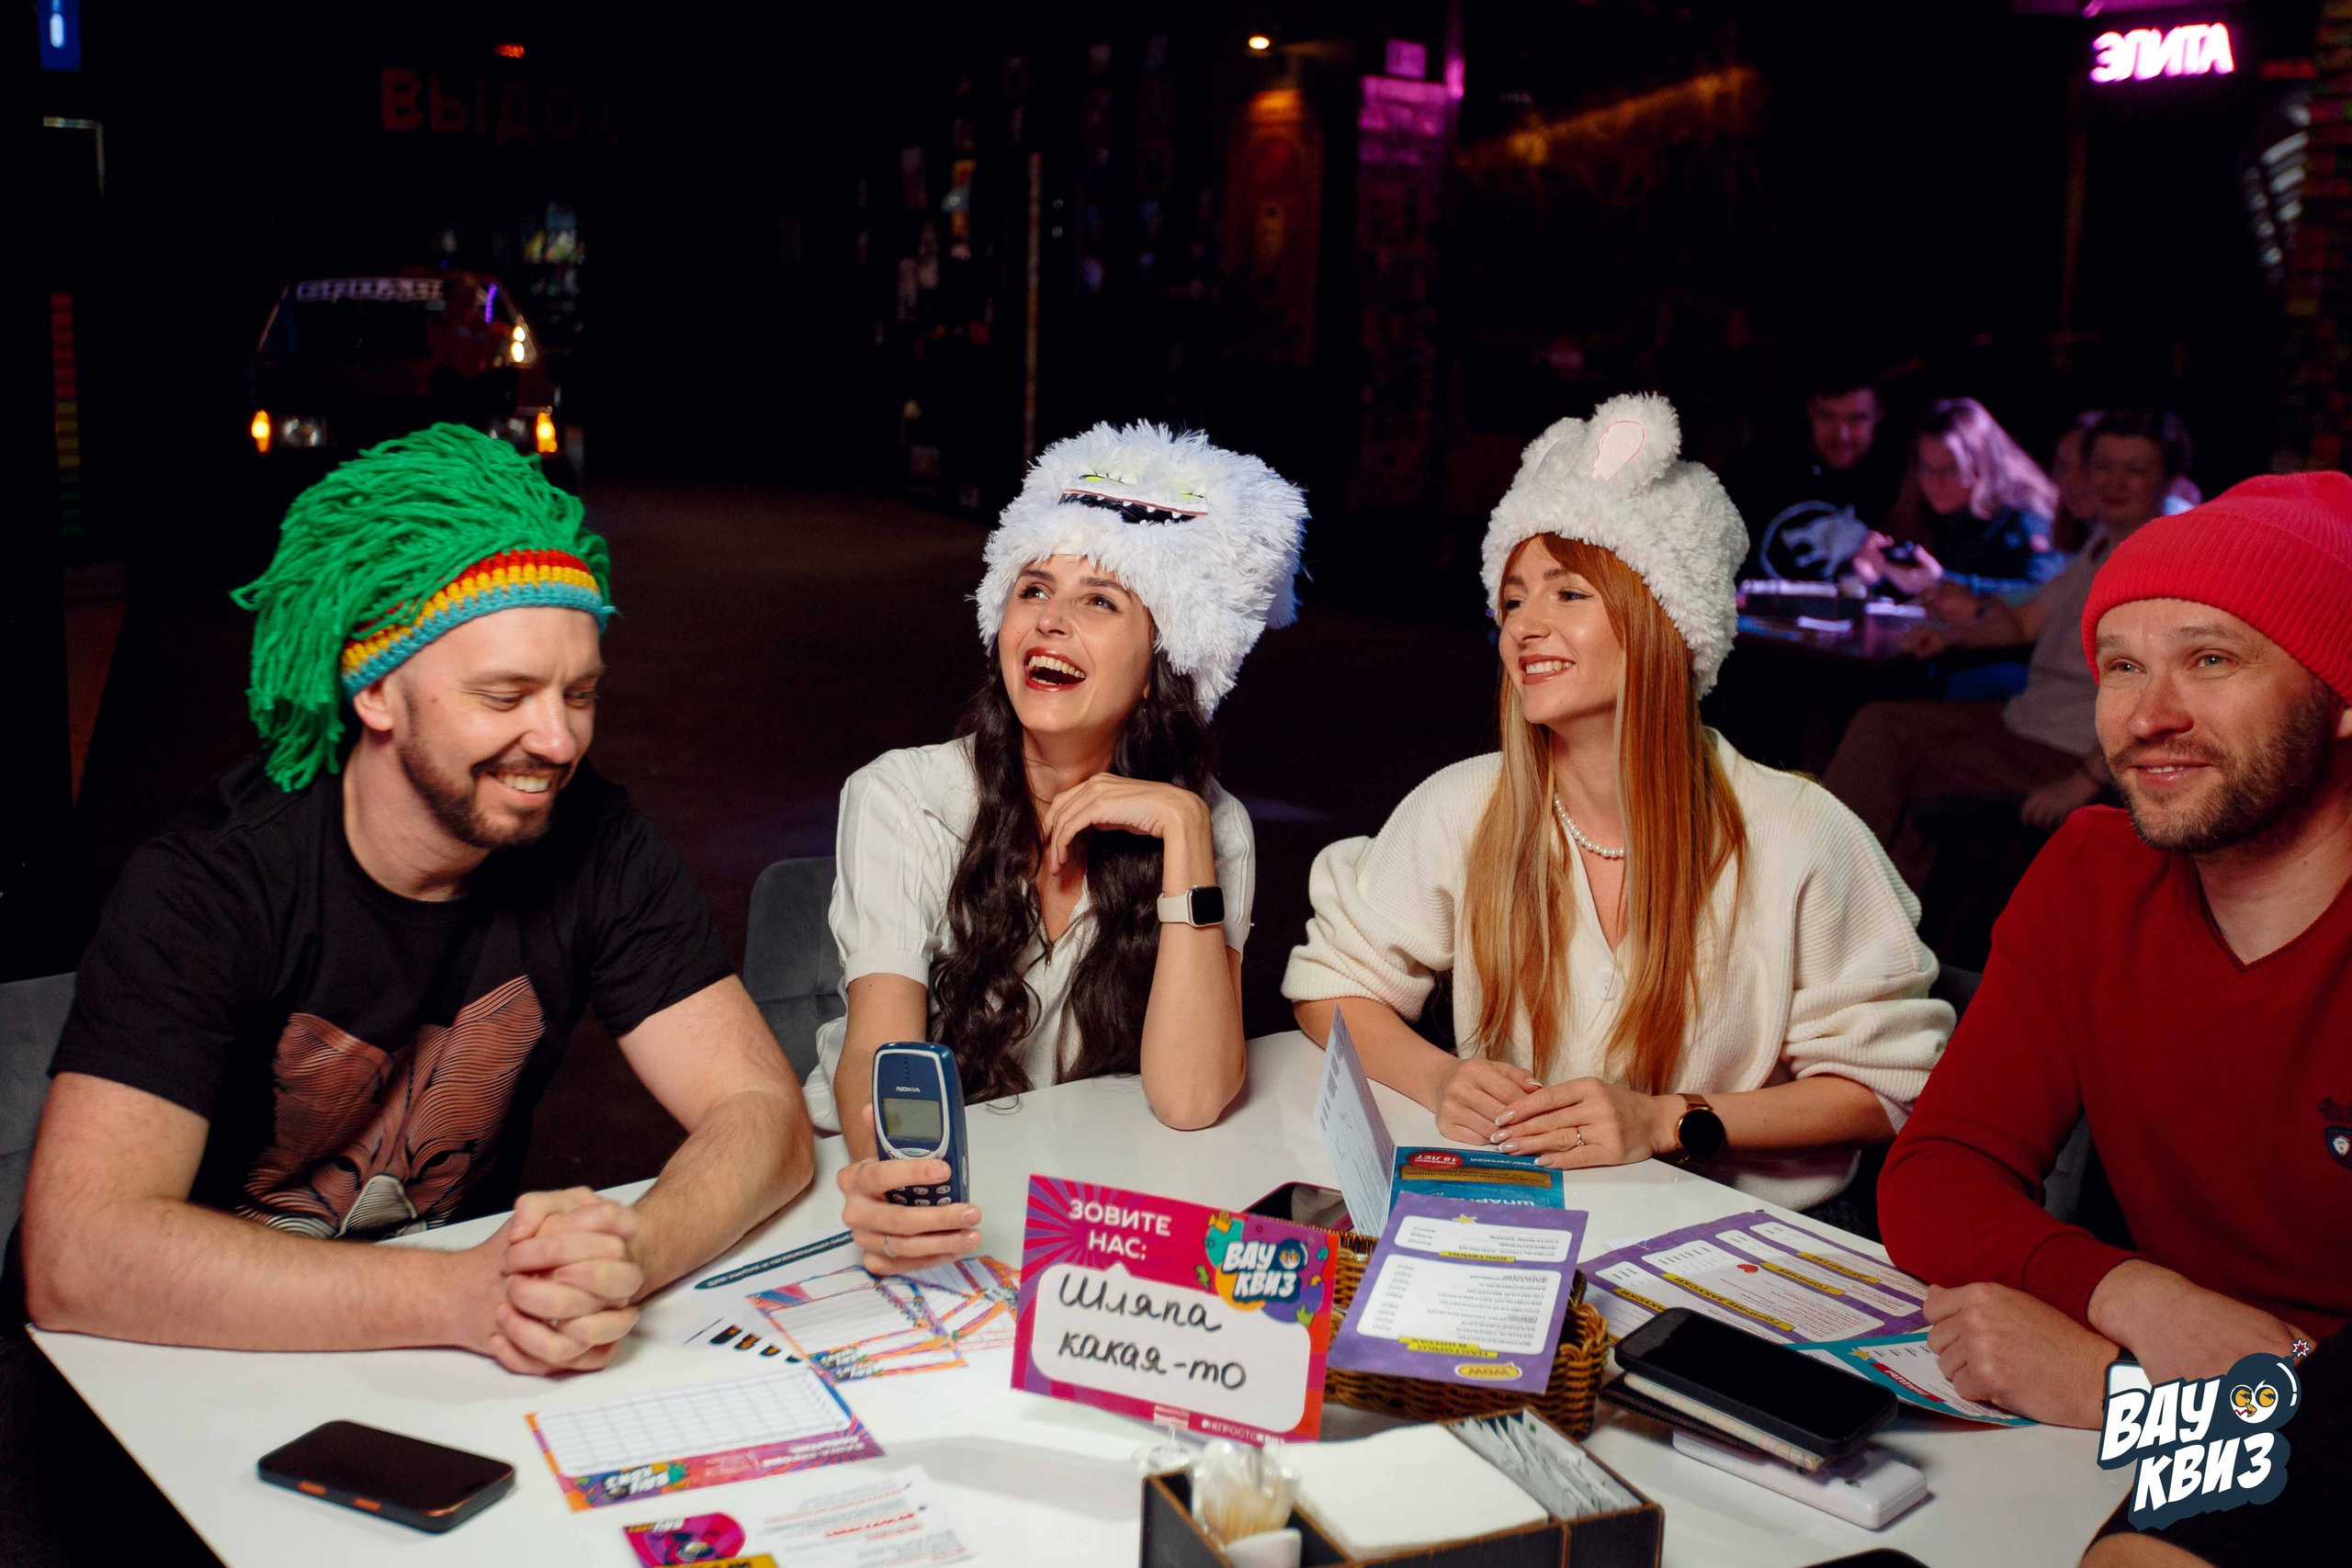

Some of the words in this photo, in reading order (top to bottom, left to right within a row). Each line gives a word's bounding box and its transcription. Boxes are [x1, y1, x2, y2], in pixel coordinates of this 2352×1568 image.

[2090, 22, 2235, 83] ЭЛИТА
[1414, 1157, 1456, 1166] ОСОБЕННО
[1069, 1198, 1171, 1237] ЗОВИТЕ
[1089, 1229, 1147, 1261] НАС:
[1222, 1241, 1277, 1273] ВАУ
[1778, 1267, 1829, 1291] ГОРЯЧЕЕ
[1811, 1255, 1868, 1280] ДЕСЕРТЫ
[1233, 1270, 1296, 1299] КВИЗ
[1674, 1277, 1727, 1302] ЗАКУСКИ
[1058, 1271, 1222, 1333] Шляпа
[1621, 1289, 1667, 1314] АКУСКИ
[1728, 1300, 1781, 1325] ГОРЯЧИЕ
[1057, 1330, 1247, 1389] какая-то
